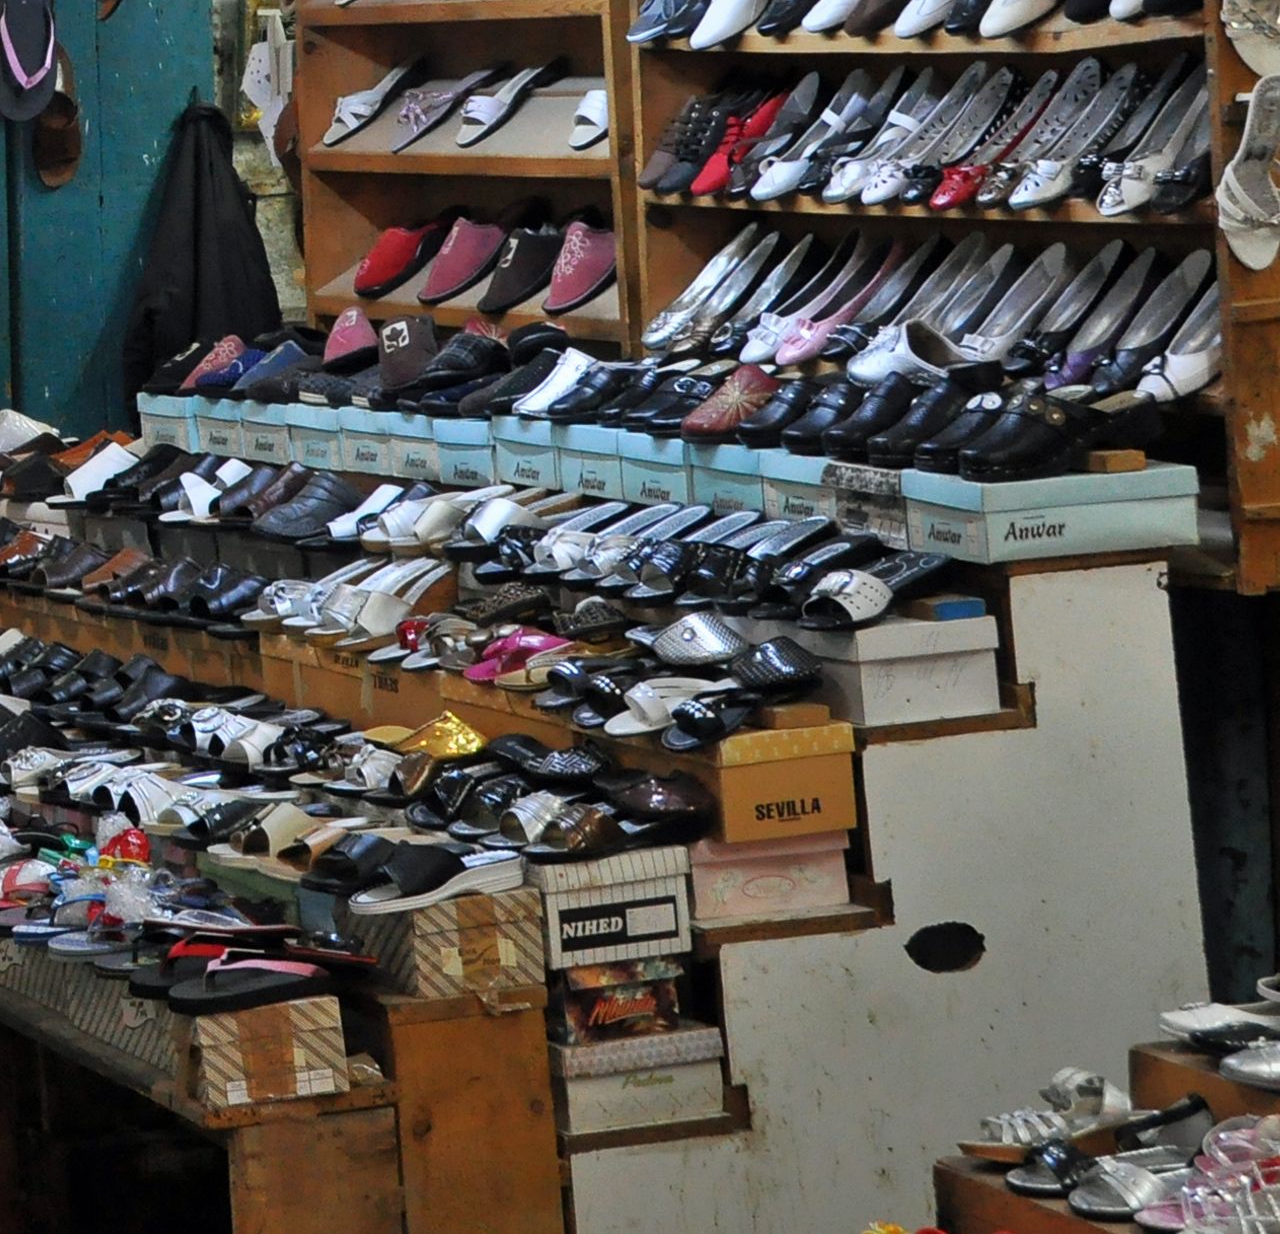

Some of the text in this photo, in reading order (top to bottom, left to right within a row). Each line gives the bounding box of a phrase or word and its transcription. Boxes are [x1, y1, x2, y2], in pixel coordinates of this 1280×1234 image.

[208, 431, 229, 446] Anwar
[254, 437, 275, 452] Anwar
[354, 447, 378, 463] Anwar
[404, 453, 428, 469] Anwar
[453, 464, 479, 481] Anwar
[512, 462, 541, 482] Anwar
[577, 471, 607, 491] Anwar
[640, 481, 672, 502] Anwar
[782, 497, 815, 516] Anwar
[927, 523, 963, 545] Anwar
[1004, 521, 1067, 543] Anwar
[755, 797, 822, 822] SEVILLA
[561, 916, 624, 940] NIHED
